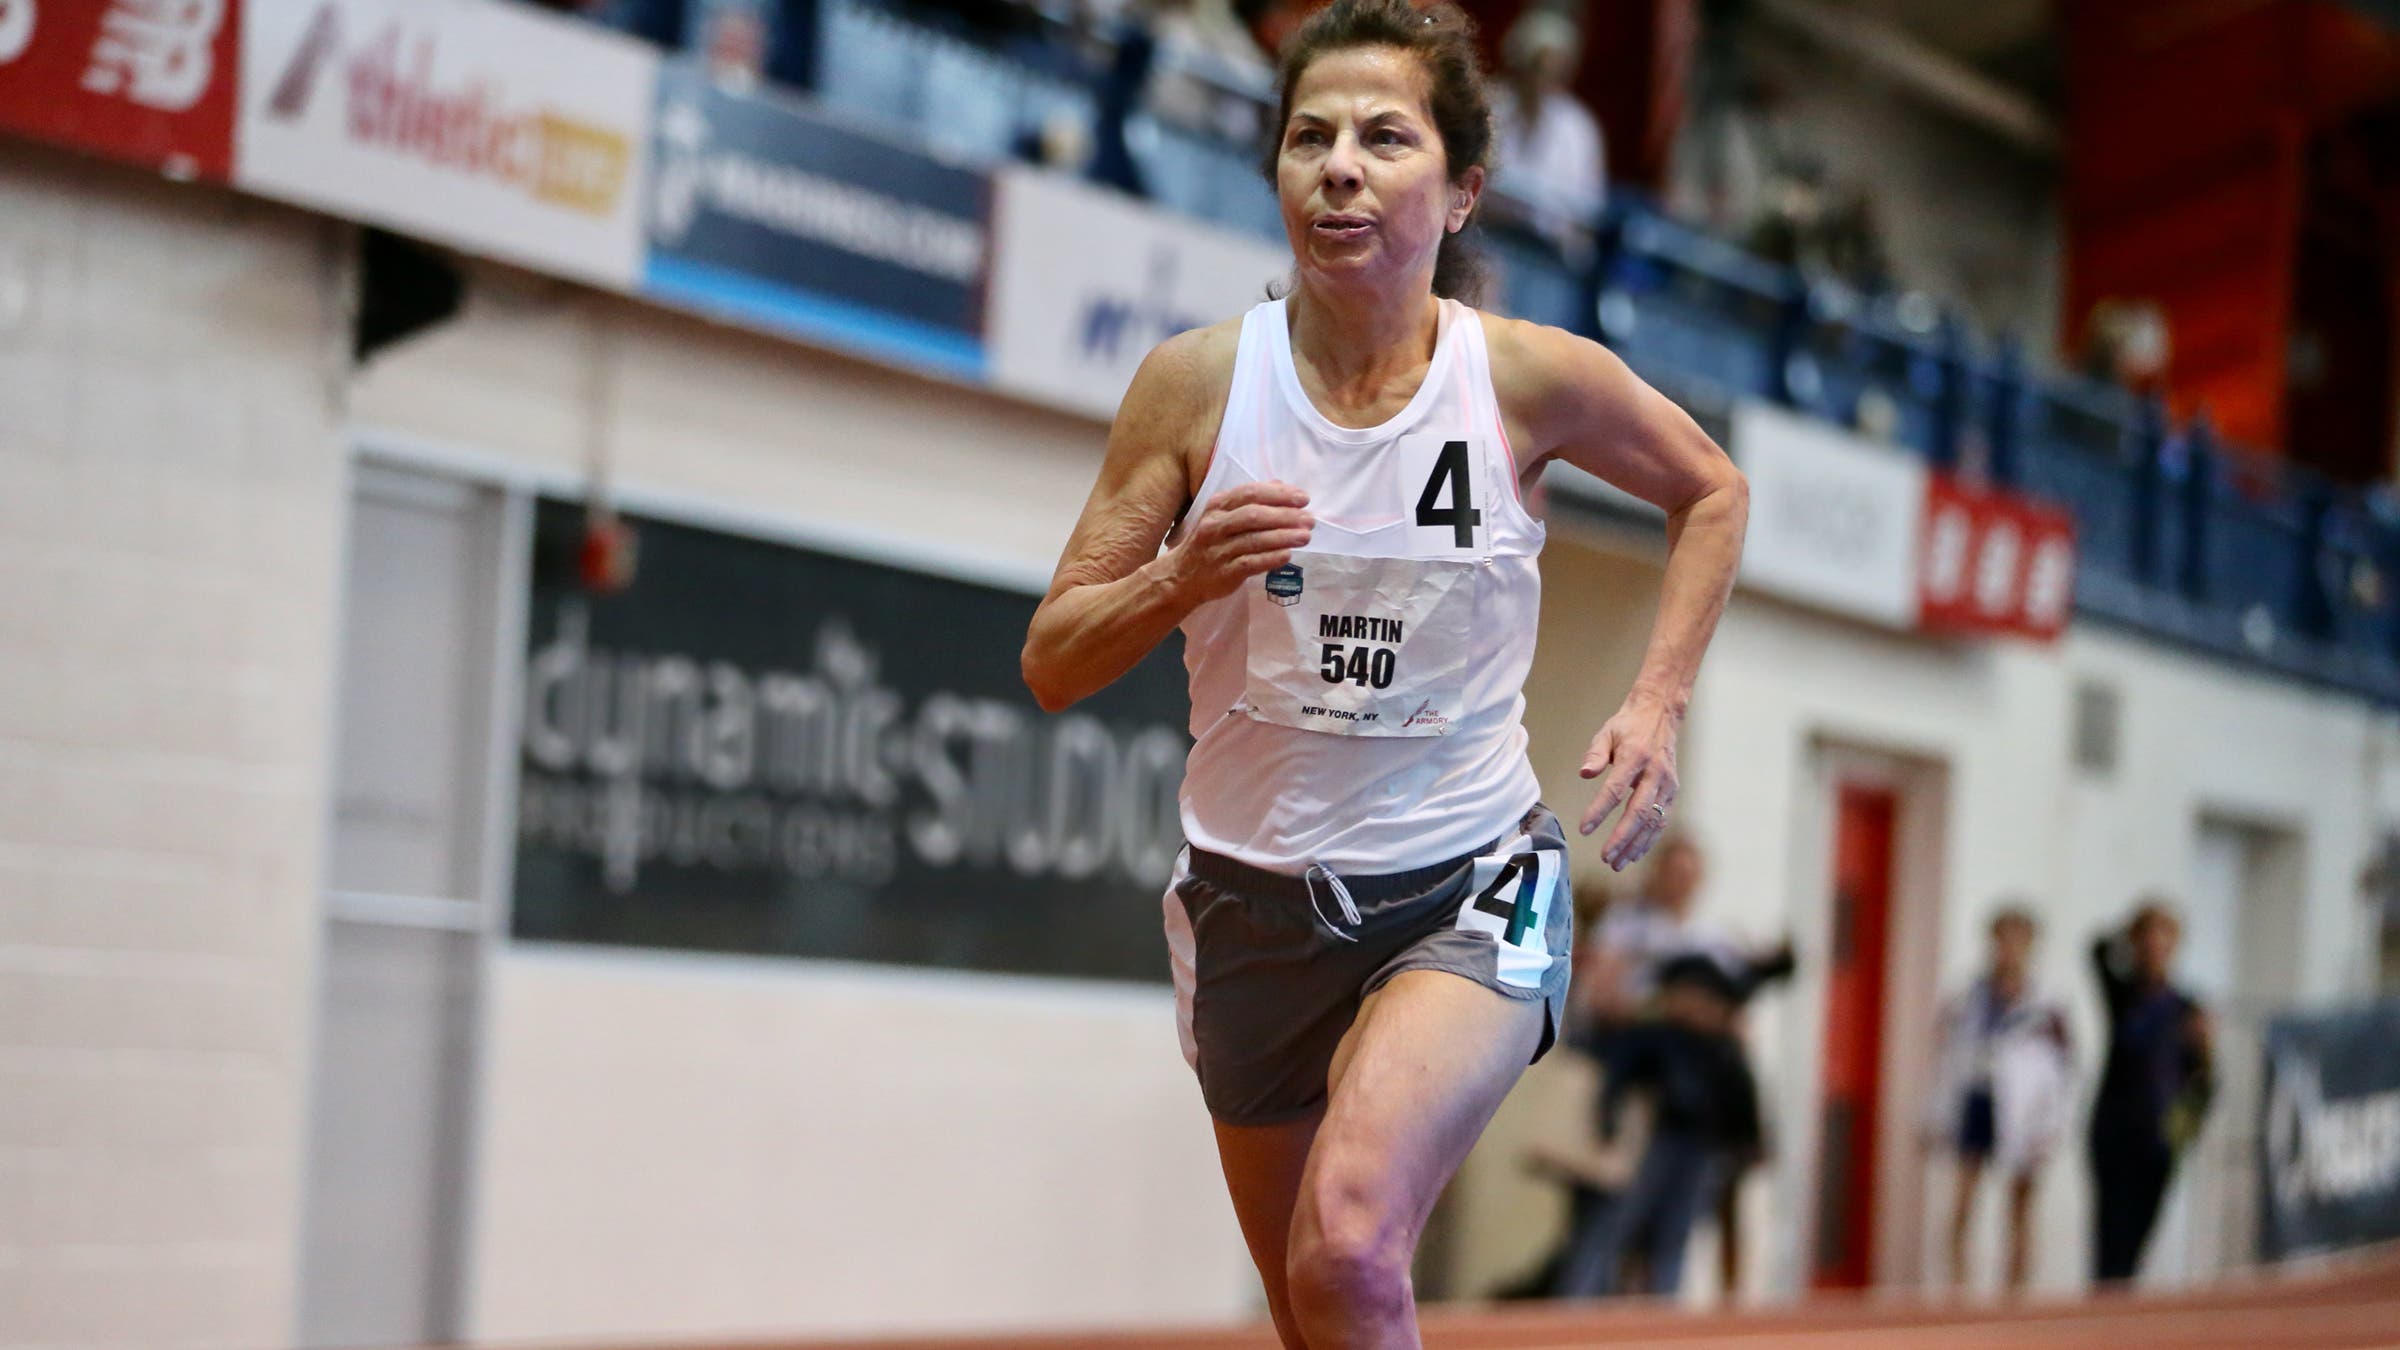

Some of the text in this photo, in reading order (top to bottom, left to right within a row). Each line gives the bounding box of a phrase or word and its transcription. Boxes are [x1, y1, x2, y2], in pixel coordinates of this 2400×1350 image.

[1415, 440, 1481, 549] 4
[1319, 614, 1403, 643] MARTIN
[1320, 643, 1396, 690] 540
[1301, 705, 1380, 722] NEW YORK, NY
[1416, 717, 1448, 725] ARMORY
[528, 603, 899, 894] dynamic
[1472, 852, 1538, 947] 4
